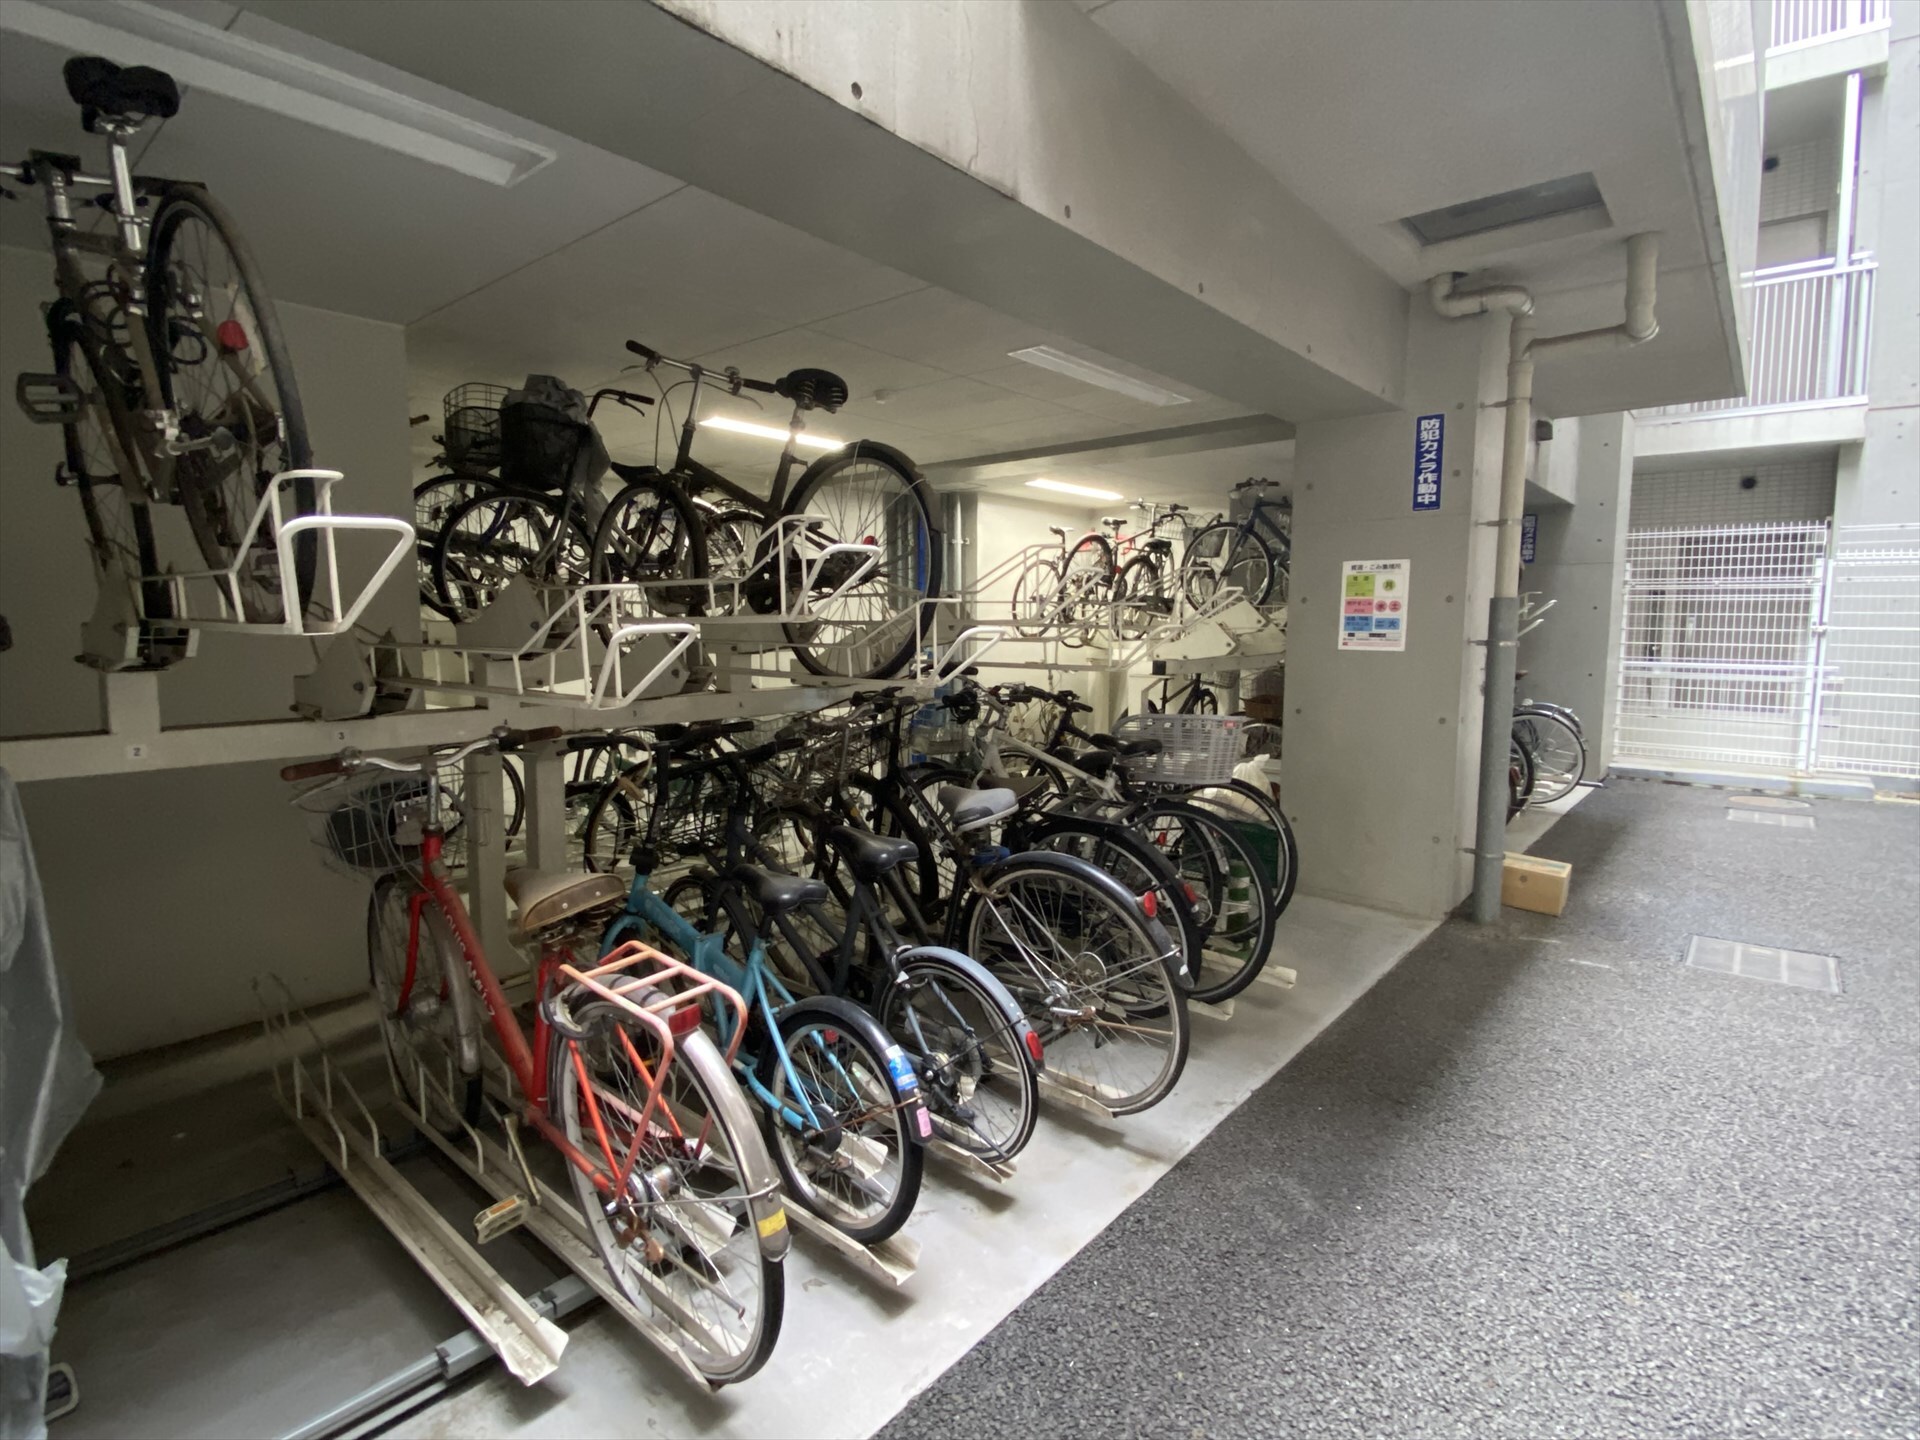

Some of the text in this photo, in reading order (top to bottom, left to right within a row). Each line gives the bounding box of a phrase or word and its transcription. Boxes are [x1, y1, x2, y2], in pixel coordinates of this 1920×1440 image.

[1417, 418, 1440, 505] 防犯カメラ作動中
[338, 731, 345, 740] 3
[133, 747, 141, 757] 2
